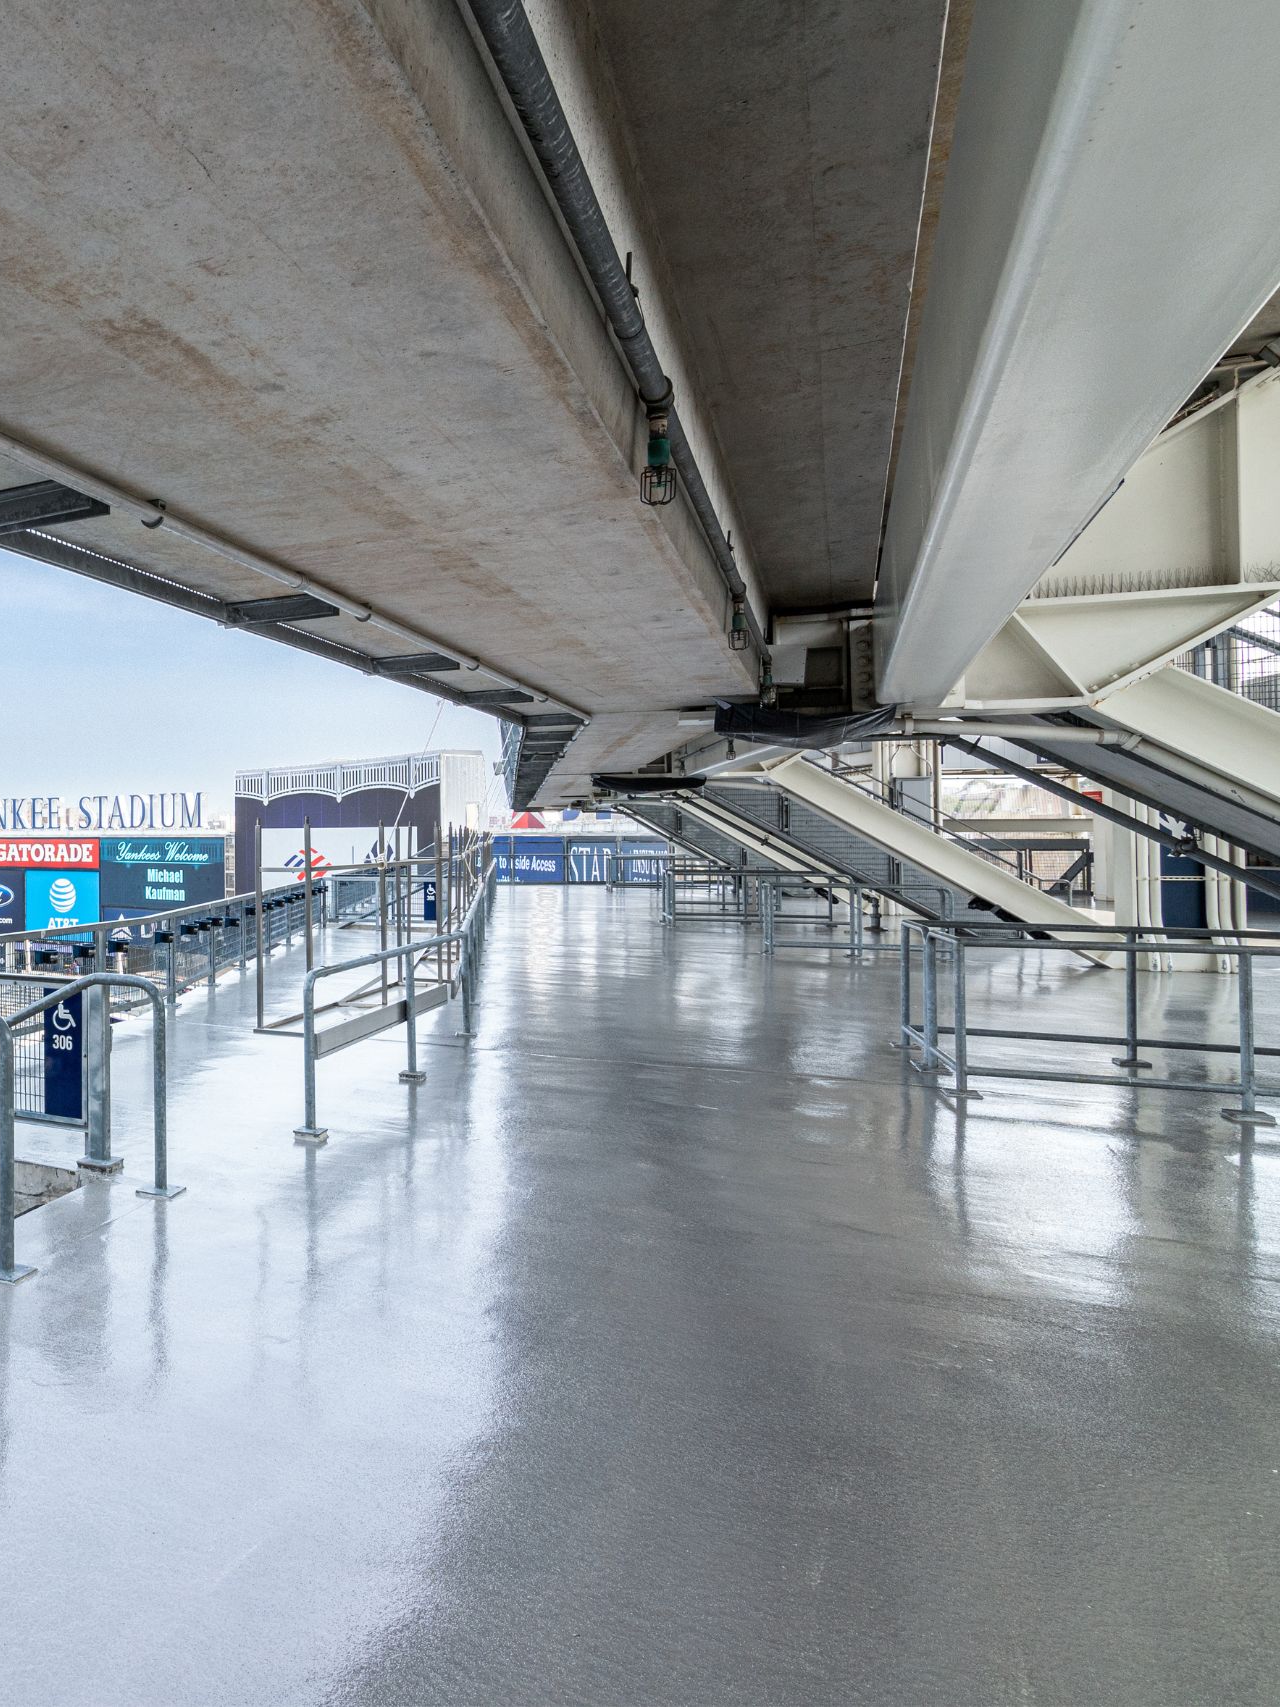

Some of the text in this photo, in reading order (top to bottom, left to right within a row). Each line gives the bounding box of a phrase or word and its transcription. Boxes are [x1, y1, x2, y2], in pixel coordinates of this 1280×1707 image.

[78, 792, 204, 829] STADIUM
[116, 841, 209, 862] Yankees Welcome
[499, 856, 507, 869] to
[530, 856, 556, 872] Access
[147, 868, 184, 883] Michael
[145, 886, 186, 901] Kaufman
[52, 1034, 73, 1051] 306
